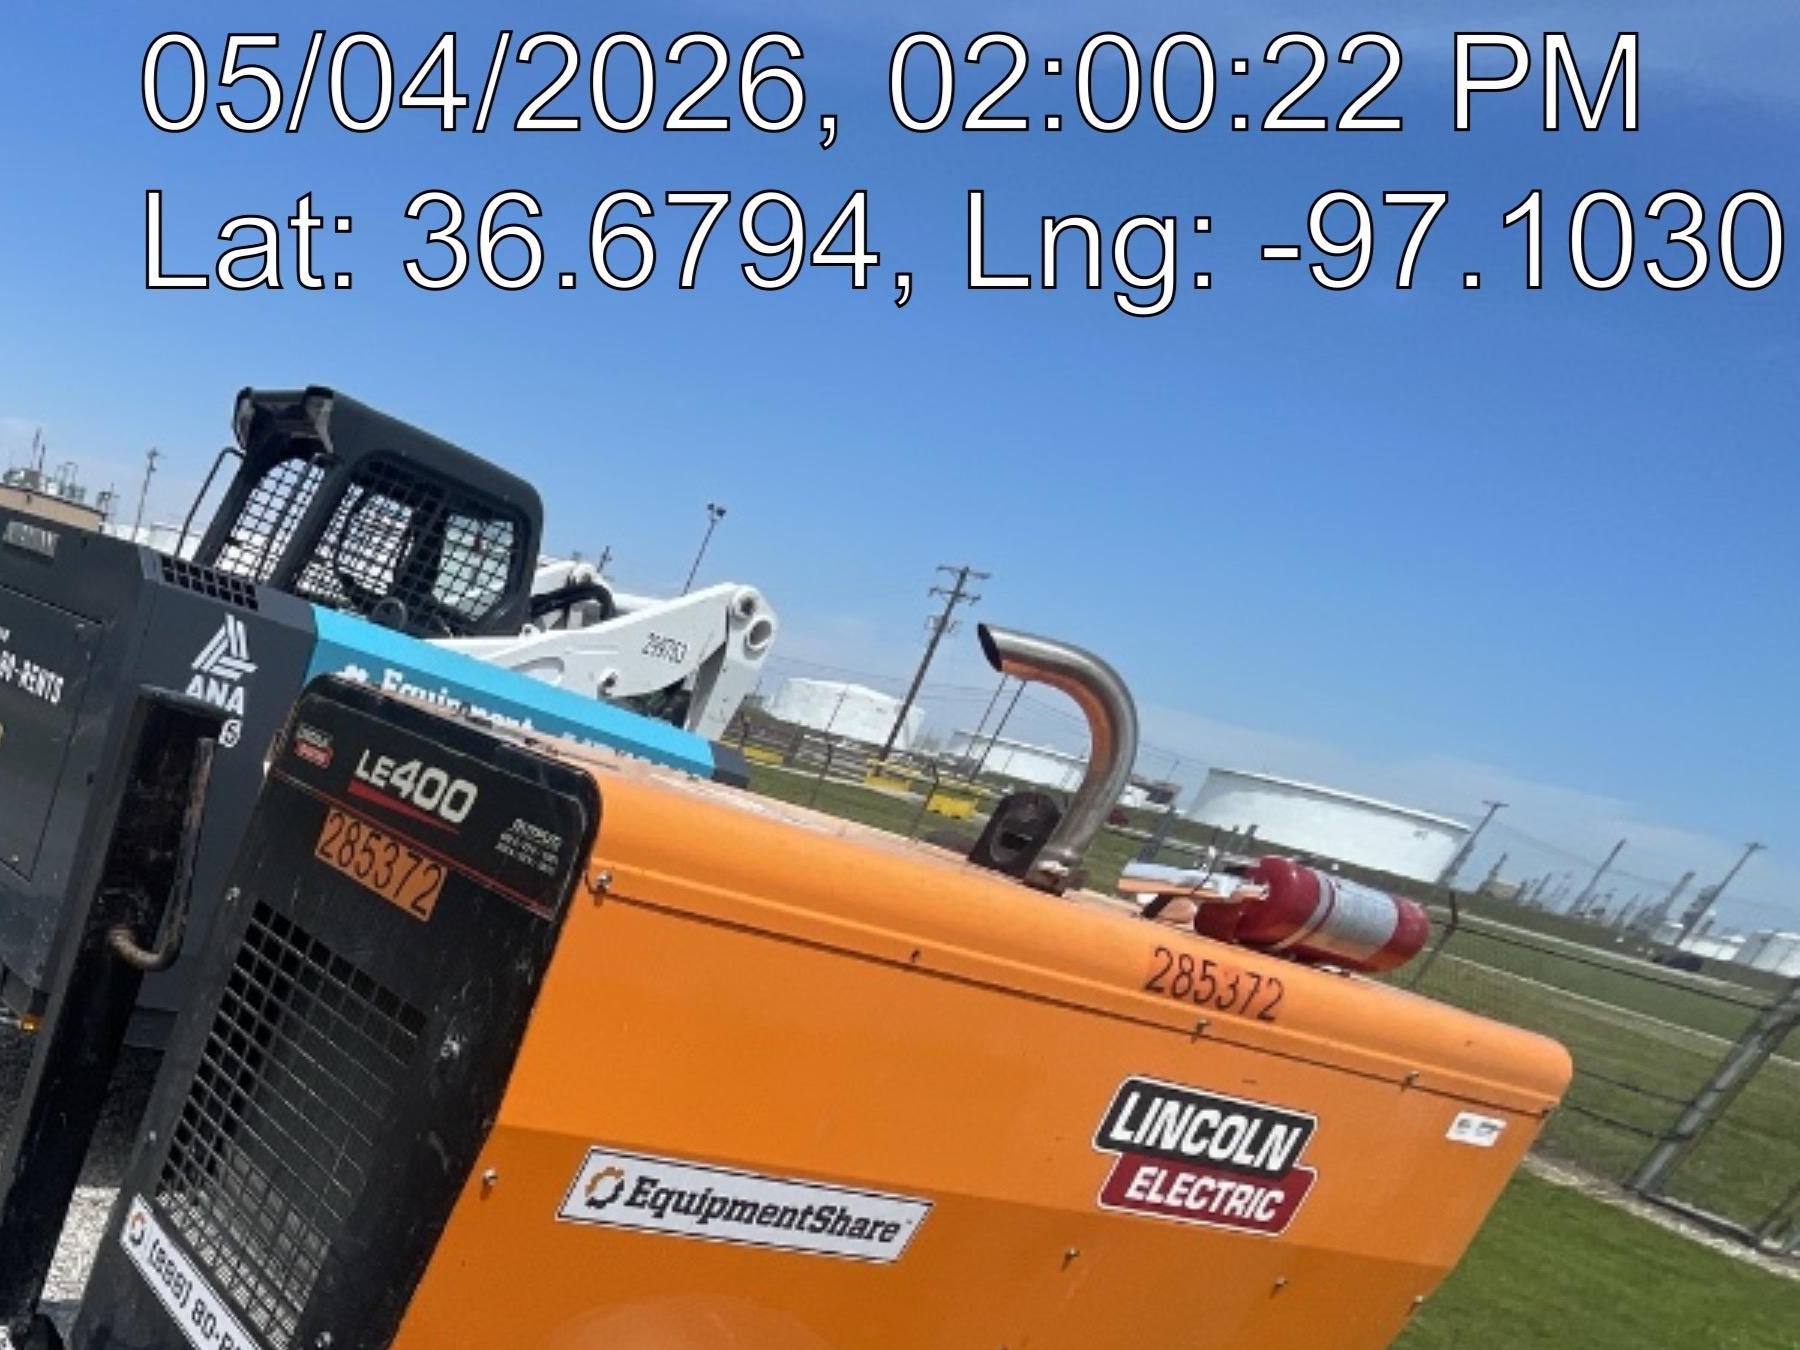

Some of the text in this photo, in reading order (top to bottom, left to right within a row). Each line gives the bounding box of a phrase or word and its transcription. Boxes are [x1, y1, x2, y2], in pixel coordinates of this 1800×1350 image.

[185, 673, 245, 716] ANA
[356, 748, 479, 823] LE400
[318, 811, 444, 917] 285372
[1145, 946, 1285, 1021] 285372
[1108, 1090, 1302, 1172] LINCOLN
[624, 1175, 902, 1244] EquipmentShare
[1124, 1165, 1286, 1222] ELECTRIC
